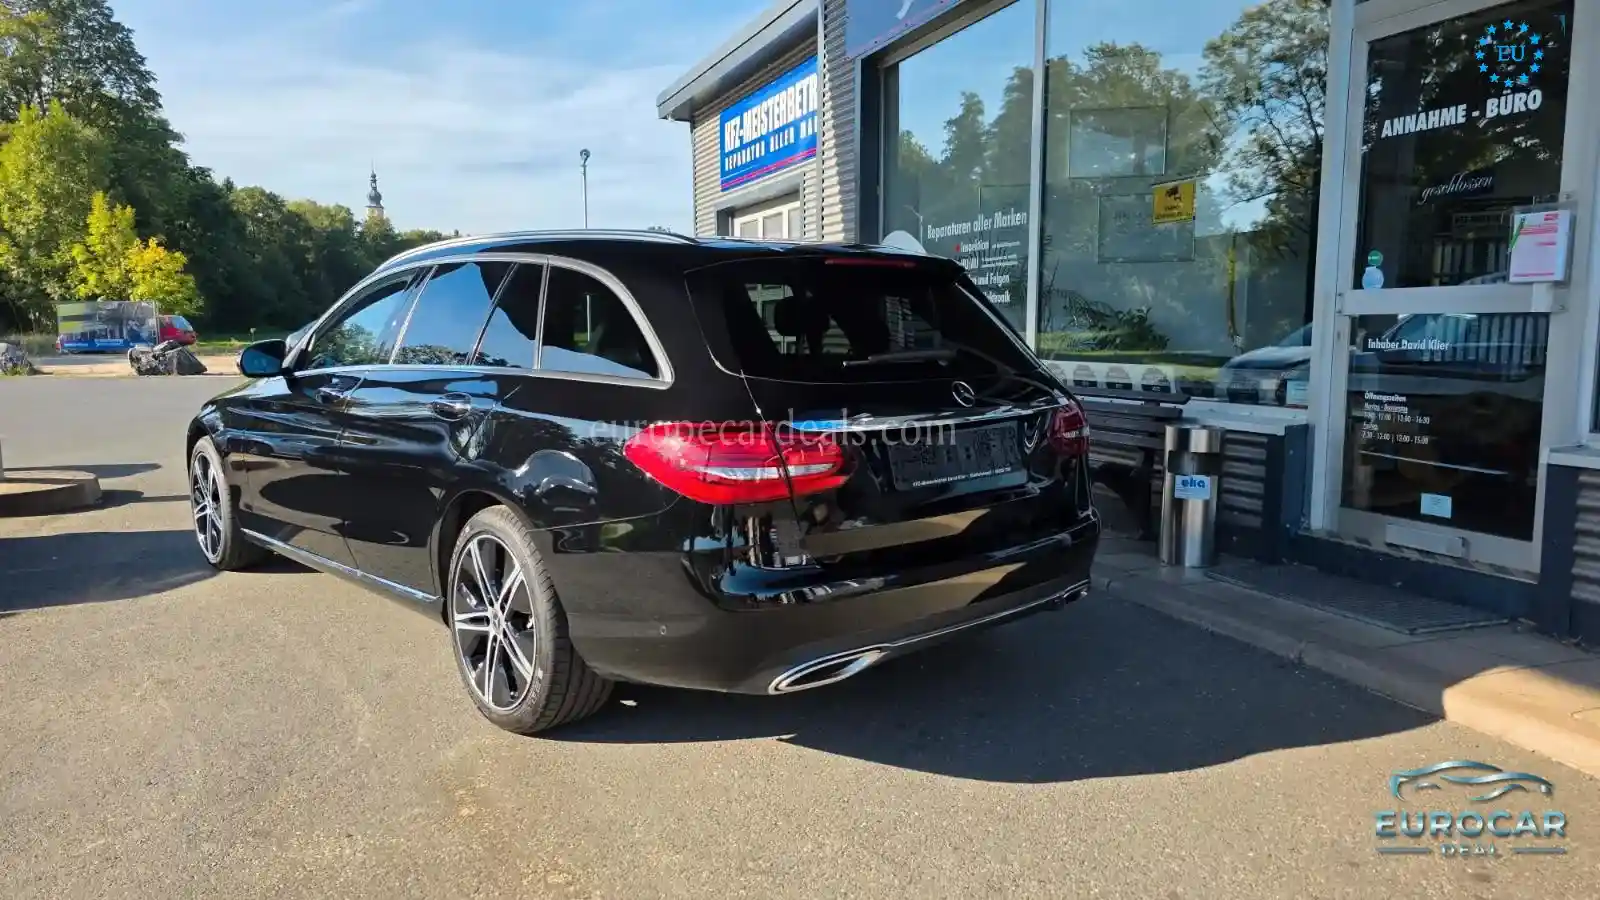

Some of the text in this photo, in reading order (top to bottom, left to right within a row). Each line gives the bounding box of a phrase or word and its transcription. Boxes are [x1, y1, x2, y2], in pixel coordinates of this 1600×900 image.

[1381, 103, 1467, 138] ANNAHME
[1486, 89, 1543, 119] BÜRO
[1417, 171, 1494, 206] geschlossen
[927, 208, 1027, 242] Reparaturen aller Marken
[1367, 338, 1400, 349] Inhaber
[1401, 338, 1426, 350] David
